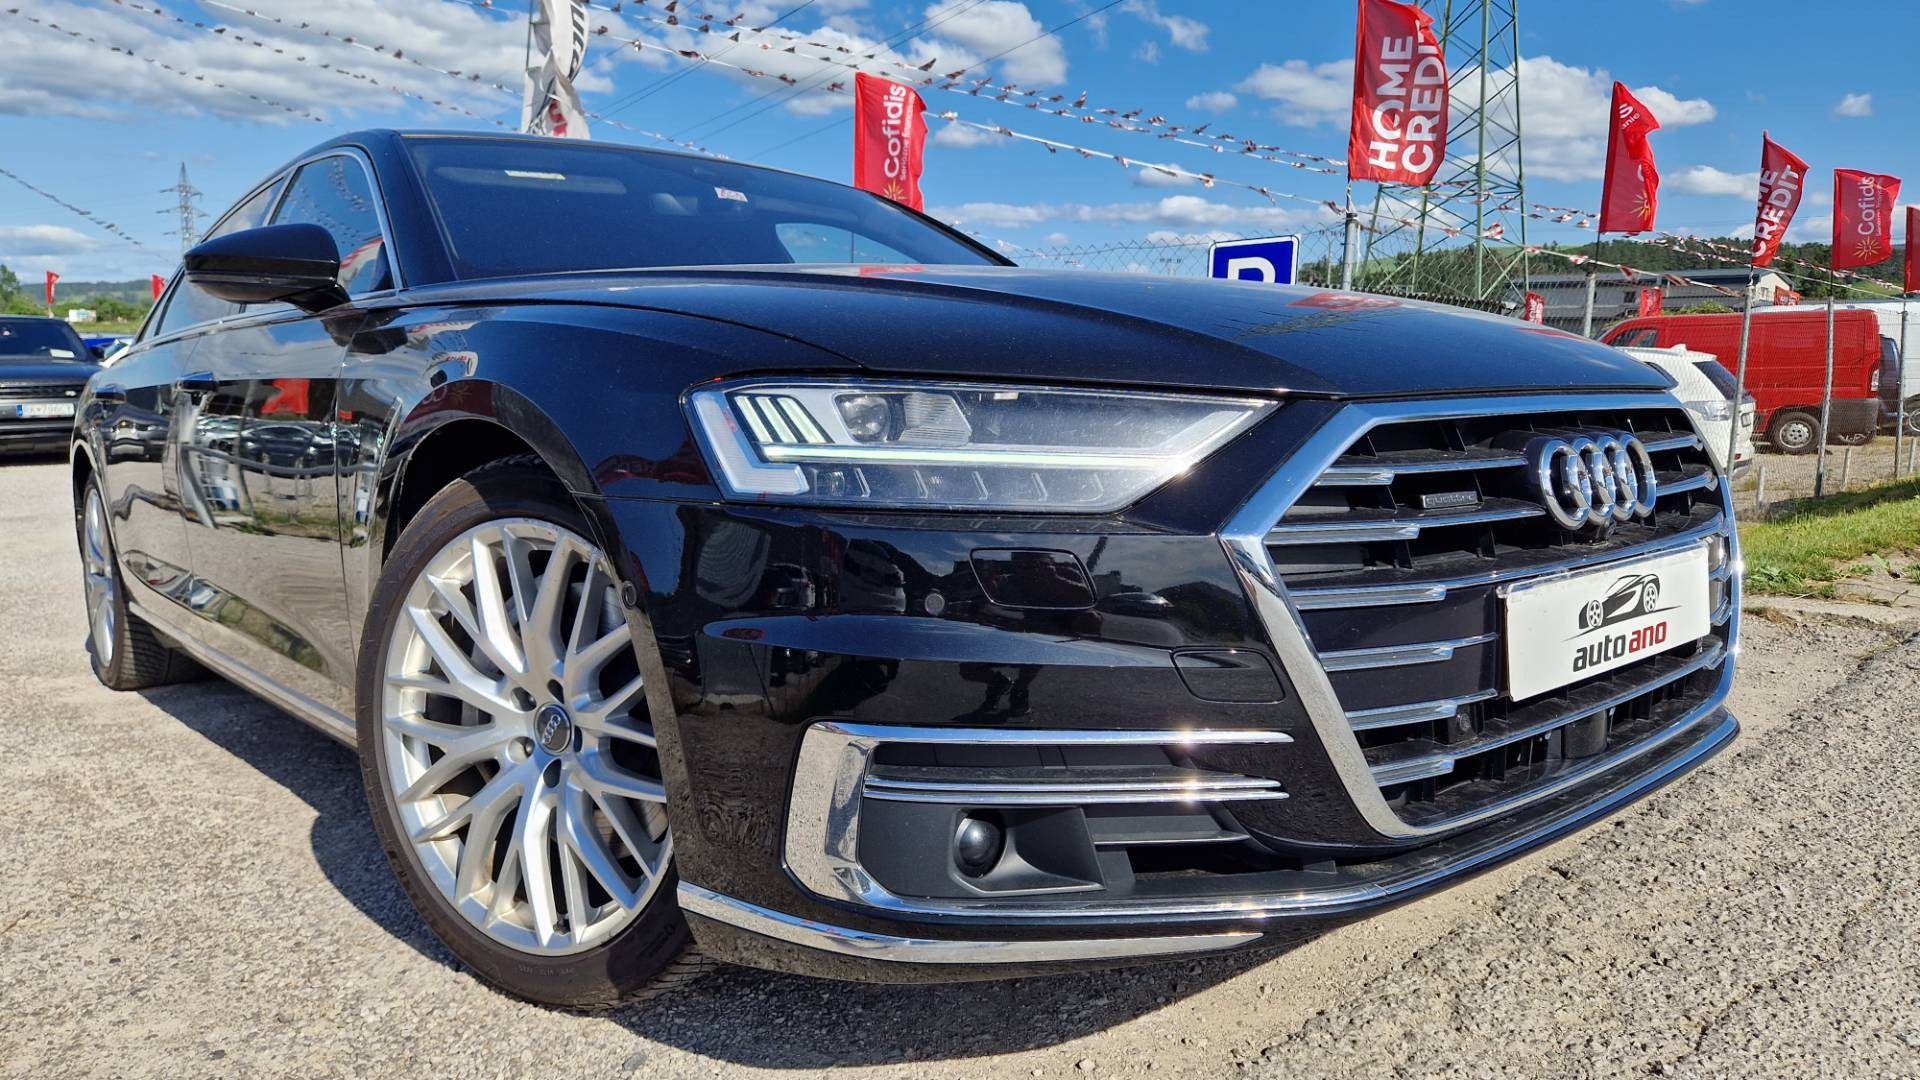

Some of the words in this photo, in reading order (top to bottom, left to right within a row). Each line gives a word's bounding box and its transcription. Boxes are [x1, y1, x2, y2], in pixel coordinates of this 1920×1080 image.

[882, 84, 907, 178] Cofidis
[1368, 35, 1414, 171] HOME
[1401, 18, 1445, 174] CREDIT
[1857, 175, 1876, 235] Cofidis
